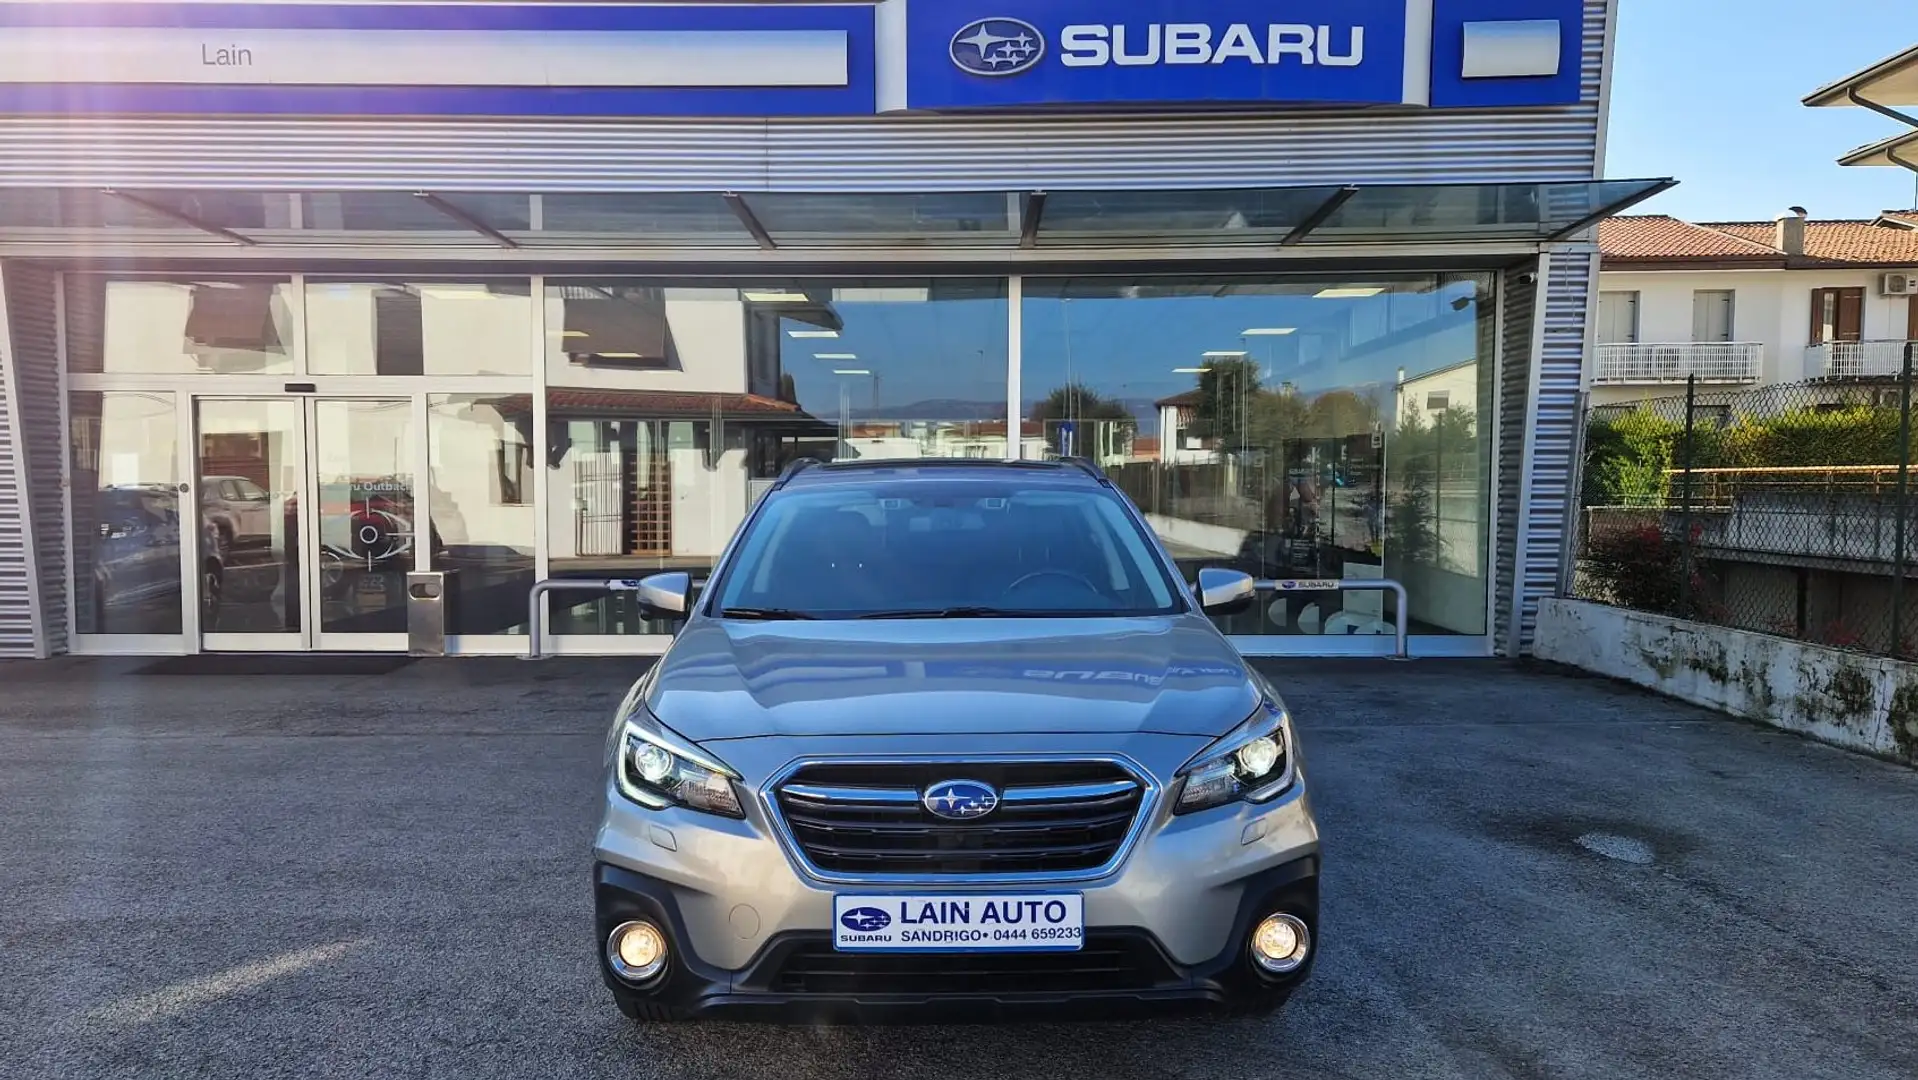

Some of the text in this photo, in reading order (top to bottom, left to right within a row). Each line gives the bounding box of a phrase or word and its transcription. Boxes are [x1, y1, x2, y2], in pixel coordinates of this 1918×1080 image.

[201, 43, 252, 66] Lain
[1060, 23, 1364, 67] SUBARU
[1298, 581, 1334, 589] SUBARU
[900, 900, 1067, 924] LAIN AUTO
[840, 934, 892, 942] SUBARU
[993, 927, 1027, 941] 0444
[1031, 926, 1082, 940] 659233
